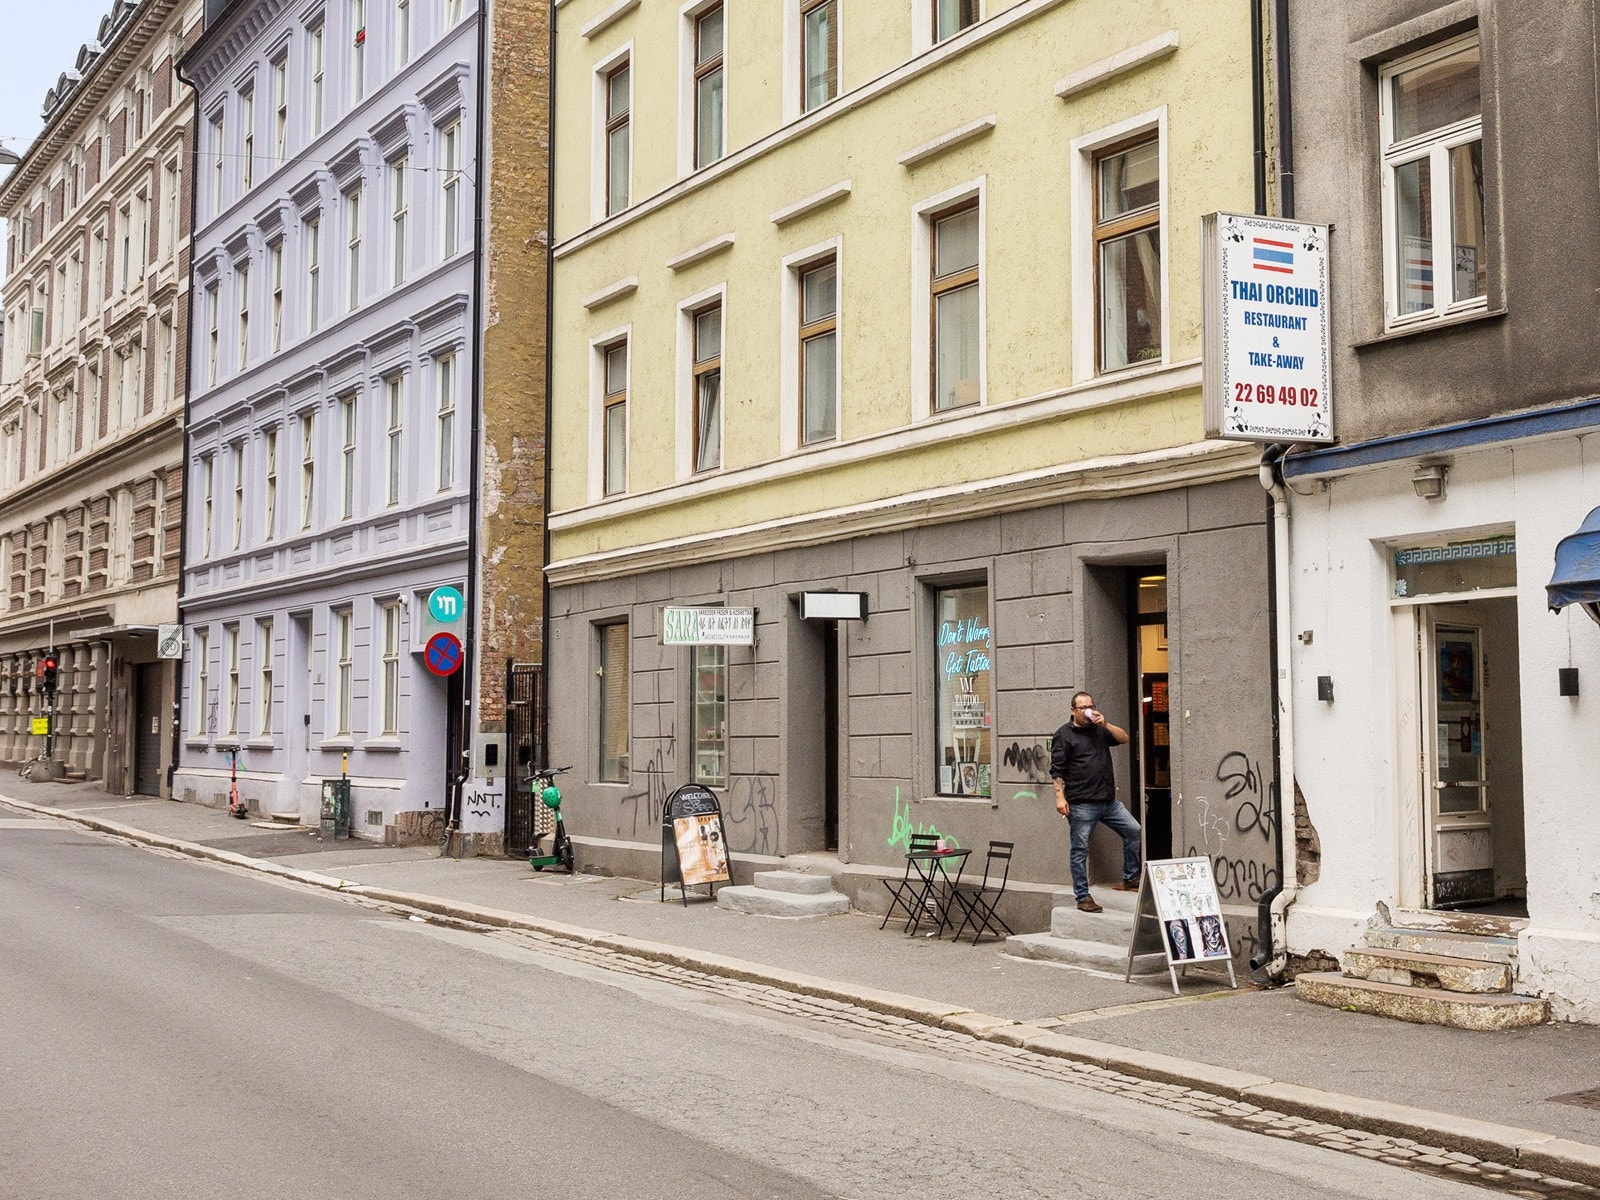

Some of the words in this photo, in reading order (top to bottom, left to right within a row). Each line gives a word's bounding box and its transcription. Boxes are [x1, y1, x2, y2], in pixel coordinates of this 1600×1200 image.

[1231, 280, 1263, 302] THAI
[1266, 283, 1319, 308] ORCHID
[1244, 311, 1307, 331] RESTAURANT
[1272, 336, 1280, 348] &
[1248, 351, 1304, 370] TAKE-AWAY
[1235, 382, 1253, 403] 22
[1256, 384, 1275, 405] 69
[1278, 386, 1297, 406] 49
[1300, 387, 1318, 408] 02
[665, 610, 700, 642] SARA
[940, 619, 963, 646] Don't
[945, 651, 963, 681] Get
[954, 694, 979, 706] TATTOO
